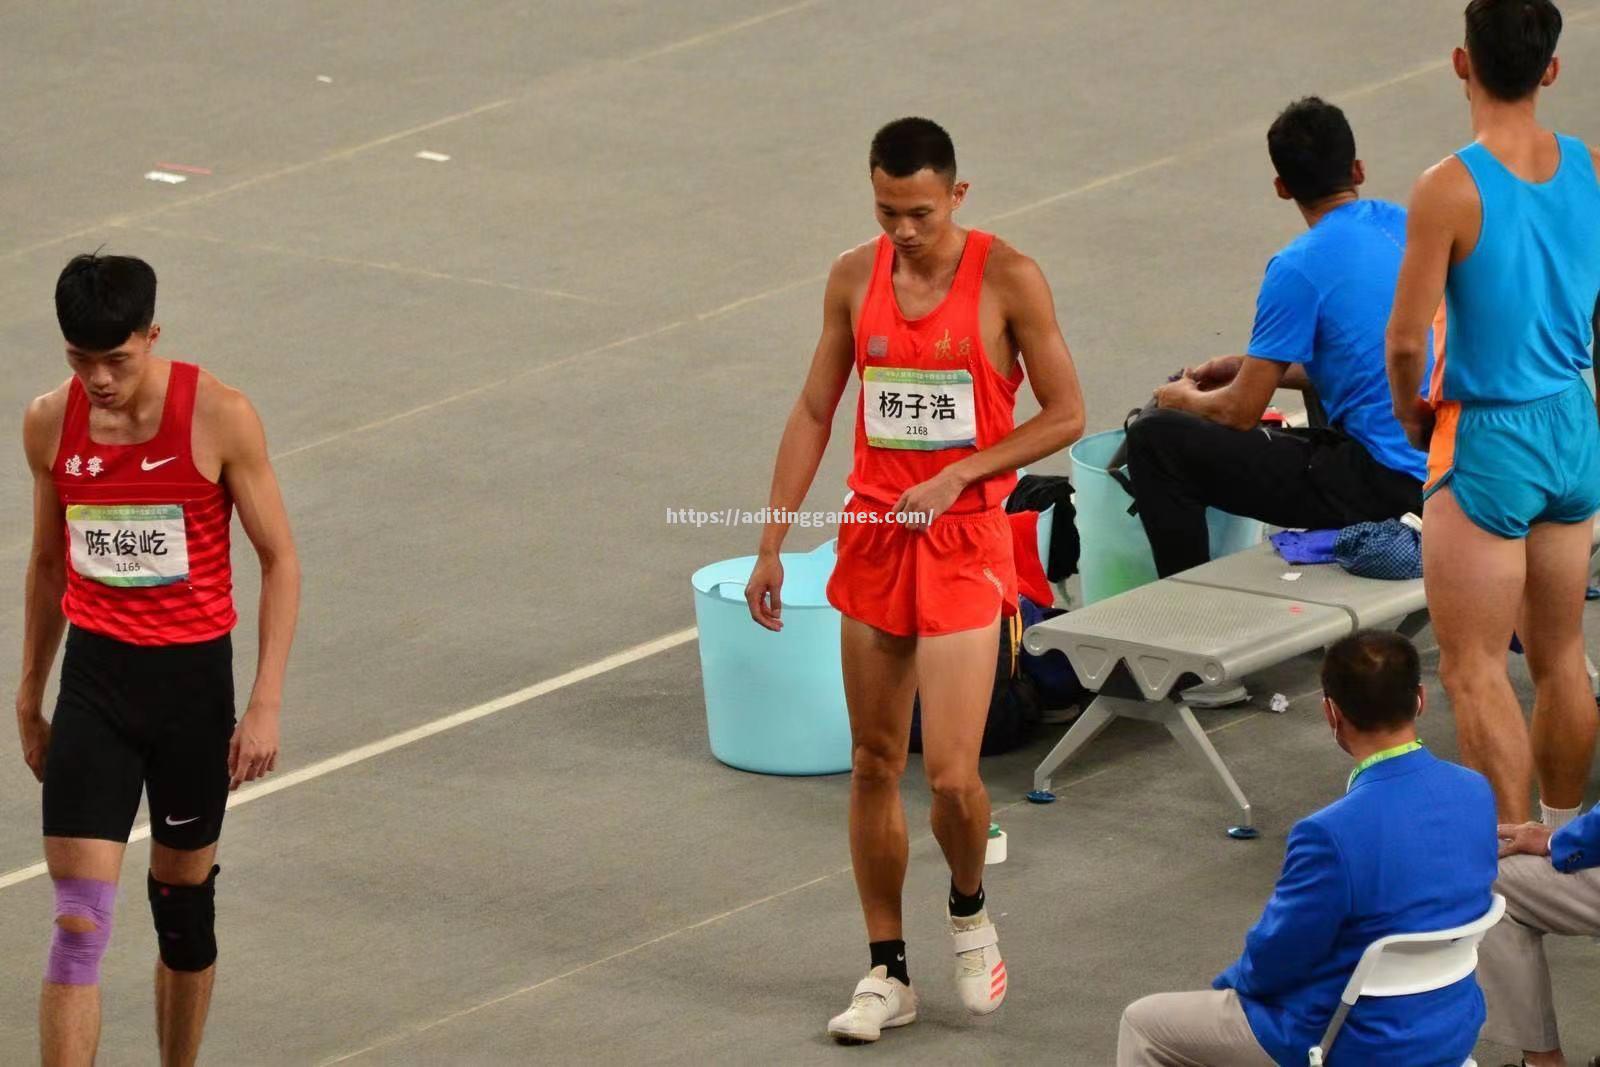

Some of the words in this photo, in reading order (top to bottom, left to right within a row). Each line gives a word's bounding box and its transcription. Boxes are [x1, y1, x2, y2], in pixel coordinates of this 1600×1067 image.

[879, 391, 956, 421] 杨子浩
[905, 426, 929, 436] 2168
[85, 529, 168, 556] 陈俊屹
[115, 562, 141, 572] 1165
